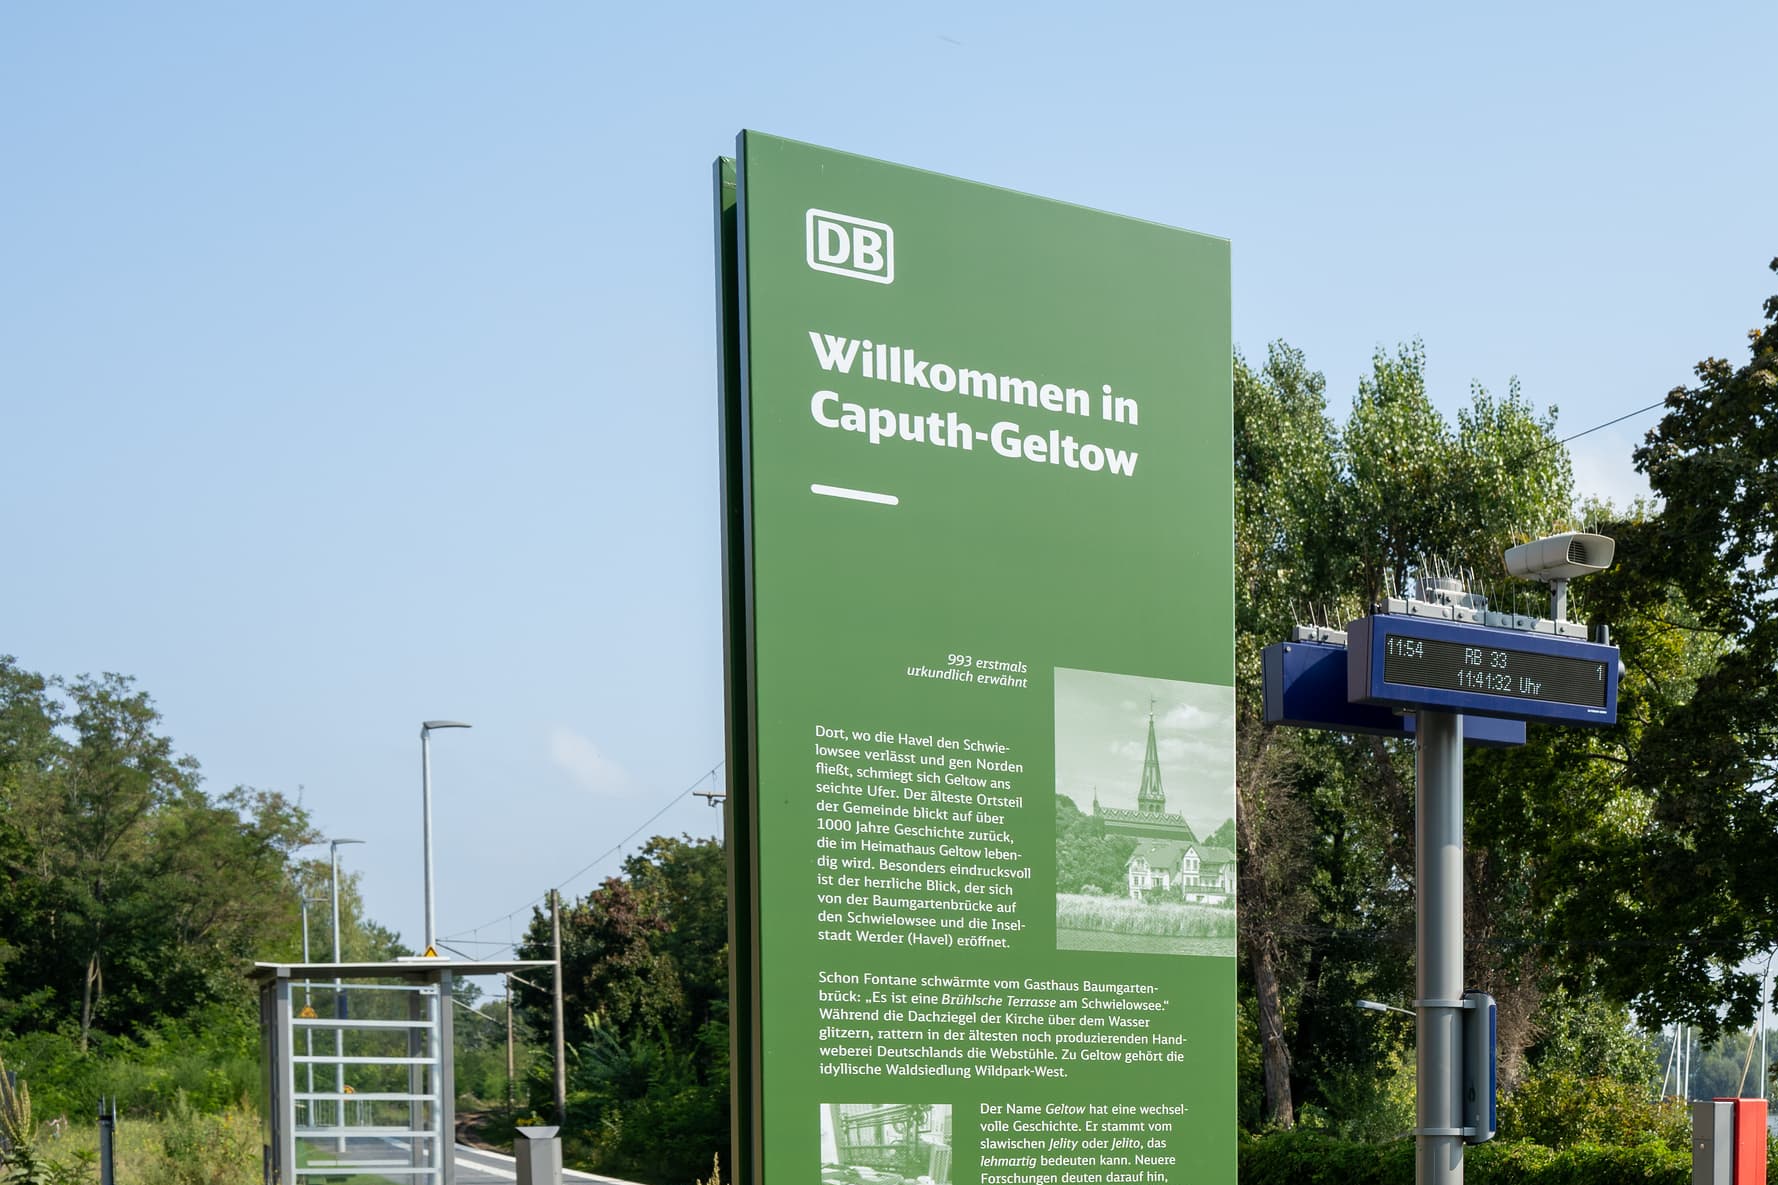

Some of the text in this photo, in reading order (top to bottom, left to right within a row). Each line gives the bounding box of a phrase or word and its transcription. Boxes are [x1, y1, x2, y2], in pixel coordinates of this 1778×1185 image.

[817, 220, 884, 272] DB
[809, 331, 1138, 425] Willkommen in
[811, 390, 1138, 476] Caputh-Geltow
[1387, 637, 1424, 659] 11:54
[1464, 648, 1508, 669] RB 33
[948, 654, 1027, 673] 993 erstmals
[1596, 664, 1603, 681] 1
[907, 666, 1027, 688] urkundlich erwähnt
[1457, 669, 1542, 695] 11:41:32 Uhr
[816, 725, 1010, 753] Dort, wo die Havel den Schwie-
[815, 744, 1023, 773] lowsee verlässt und gen Norden
[816, 762, 1011, 789] fließt, schmiegt sich Geltow ans
[816, 782, 1022, 808] seichte Ufer. Der älteste Ortsteil
[817, 818, 1013, 844] 1000 Jahre Geschichte zurück,
[817, 855, 1031, 879] dig wird. Besonders eindrucksvoll
[819, 971, 1158, 995] Schon Fontane schwärmte vom Gasthaus Baumgarten-
[819, 990, 860, 1002] brück:
[891, 992, 907, 1003] ist
[911, 993, 938, 1004] eine
[941, 994, 1002, 1006] Brühlsche
[1007, 996, 1056, 1008] Terrasse
[1059, 1000, 1077, 1008] am
[1082, 998, 1169, 1011] Schwielowsee.“
[819, 1026, 1187, 1045] glitzern, rattern in der ältesten noch produzierenden Hand-
[819, 1063, 1067, 1078] idyllische Waldsiedlung Wildpark-West.
[980, 1103, 1188, 1115] Der Name Geltow hat eine wechsel-
[980, 1120, 1172, 1131] volle Geschichte. Er stammt vom
[981, 1155, 1176, 1168] lehmartig bedeuten kann. Neuere
[981, 1171, 1168, 1185] Forschungen deuten darauf hin,
